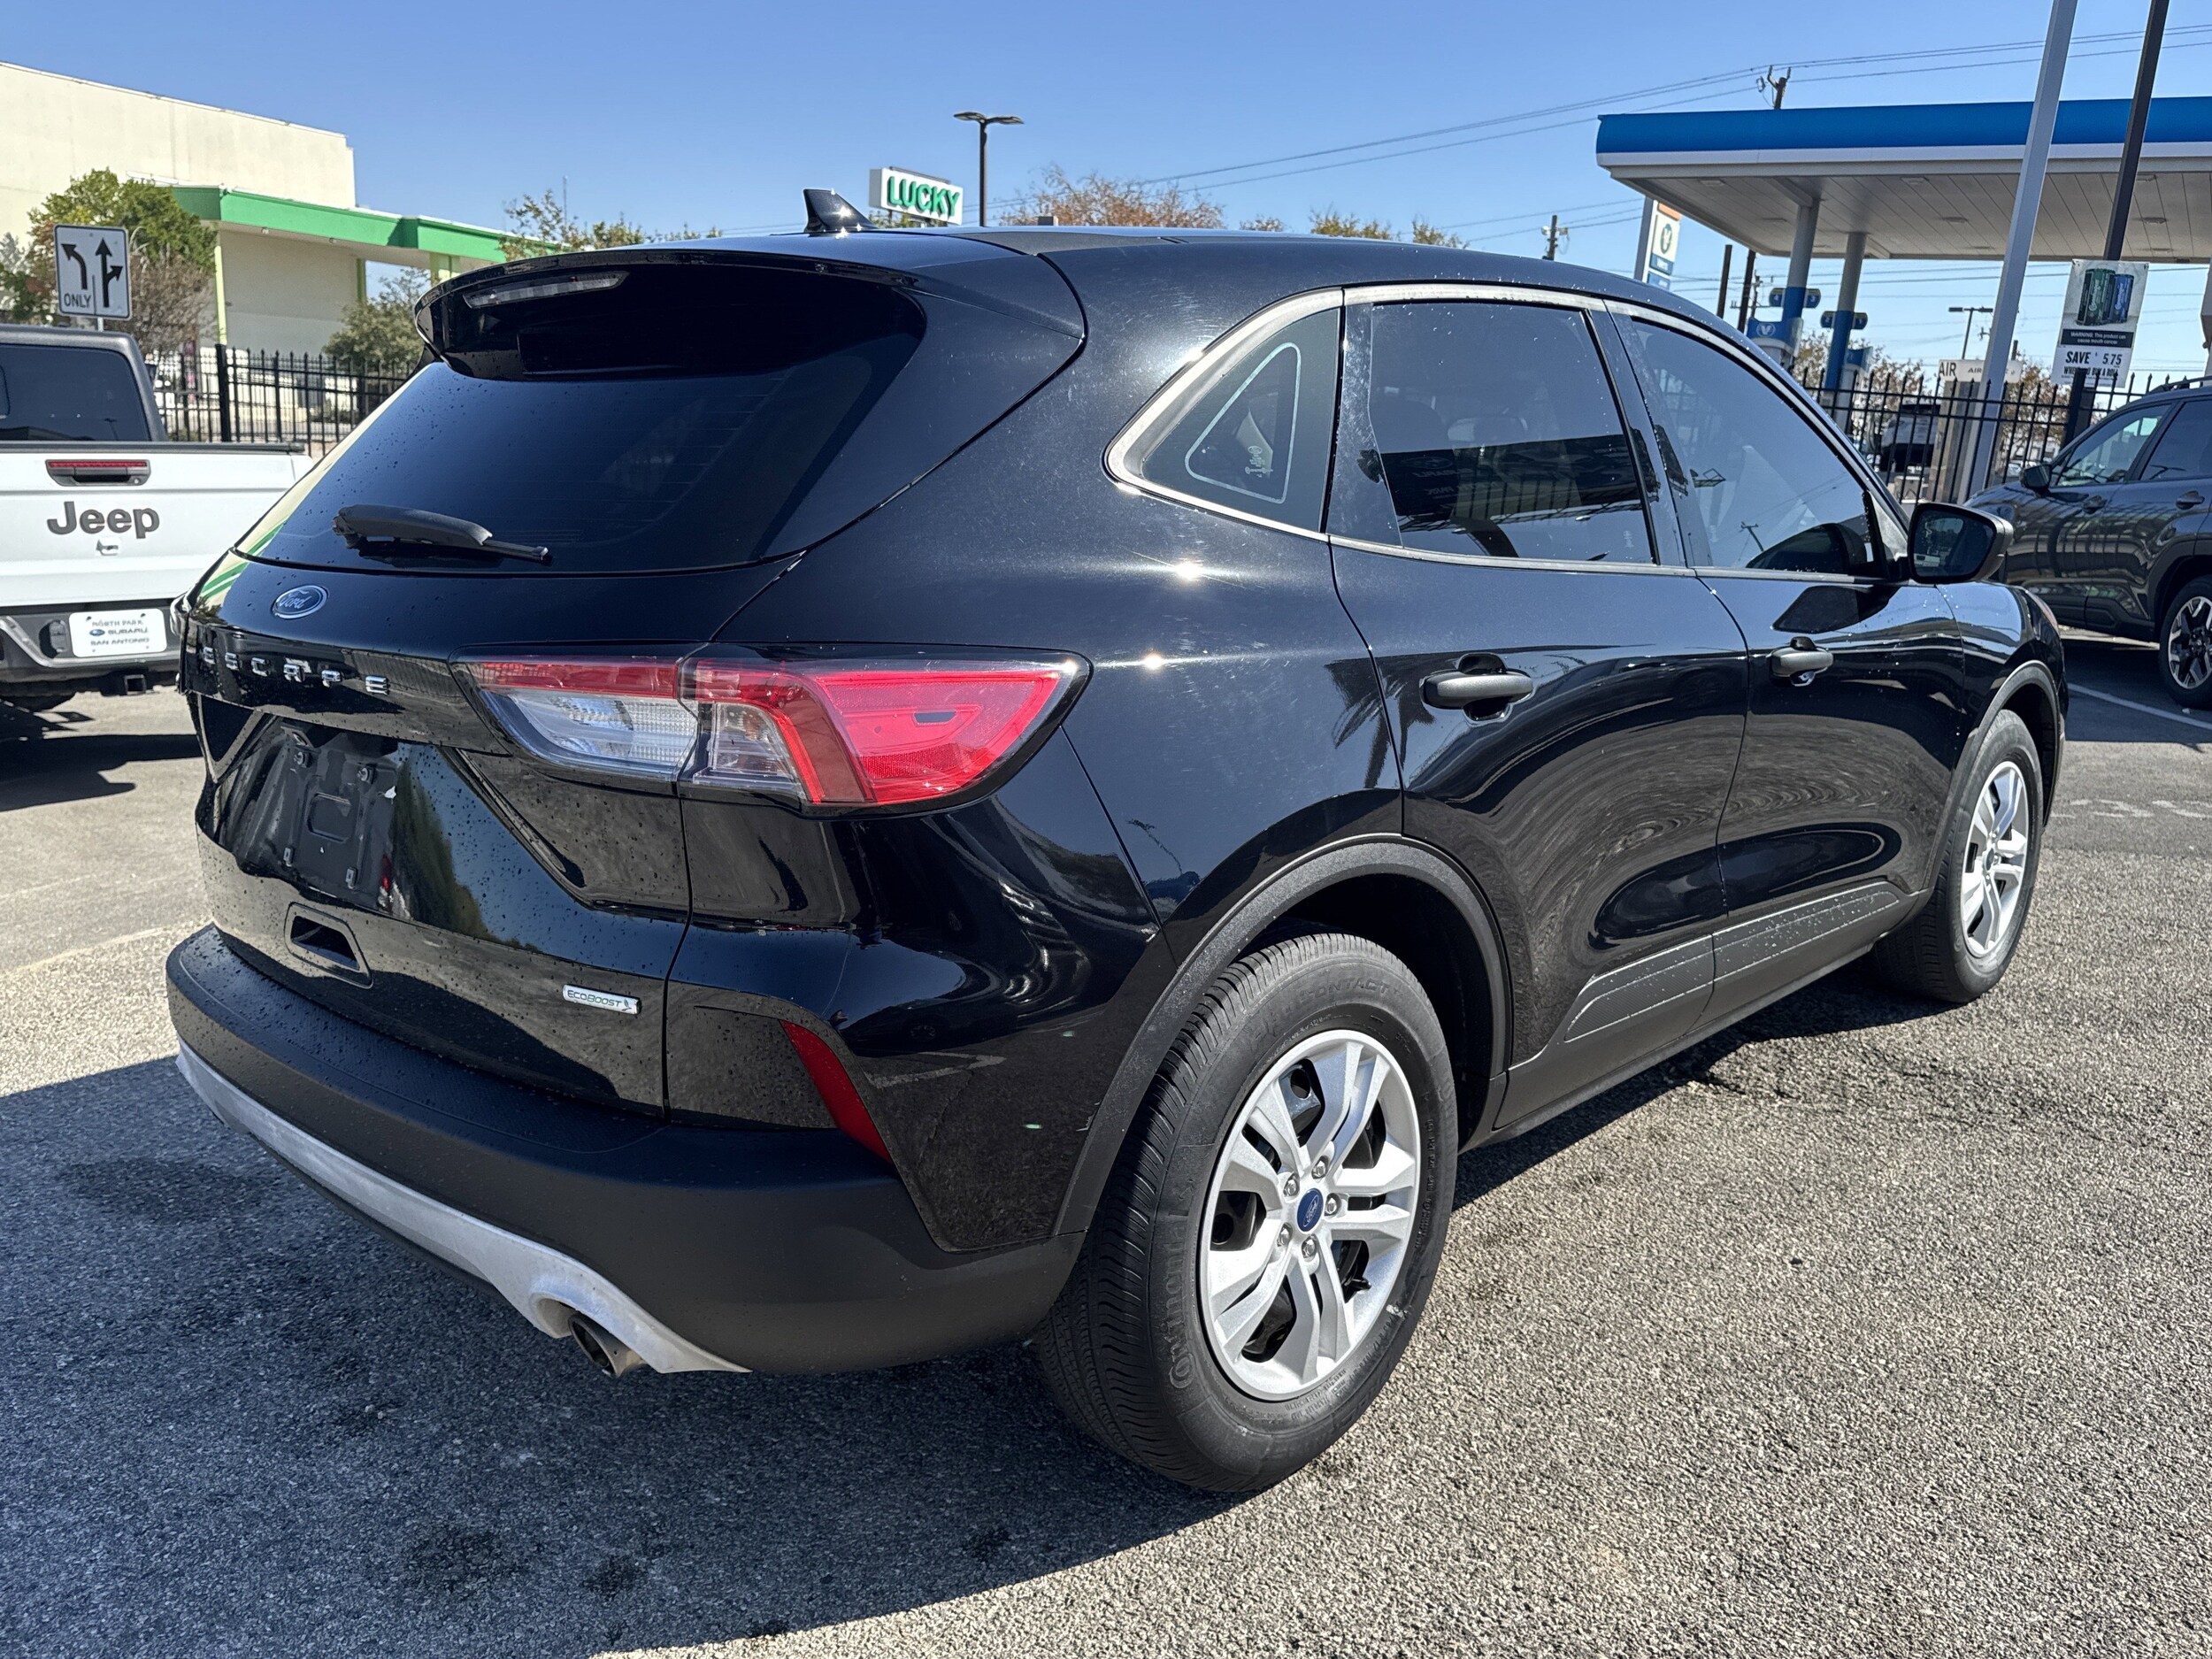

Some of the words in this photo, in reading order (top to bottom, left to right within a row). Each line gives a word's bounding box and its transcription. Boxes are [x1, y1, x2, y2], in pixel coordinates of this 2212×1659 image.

[887, 176, 960, 217] LUCKY
[64, 293, 91, 307] ONLY
[1939, 362, 1957, 377] AIR
[2065, 350, 2091, 365] SAVE
[47, 501, 160, 539] Jeep
[202, 646, 388, 695] ESCAPE
